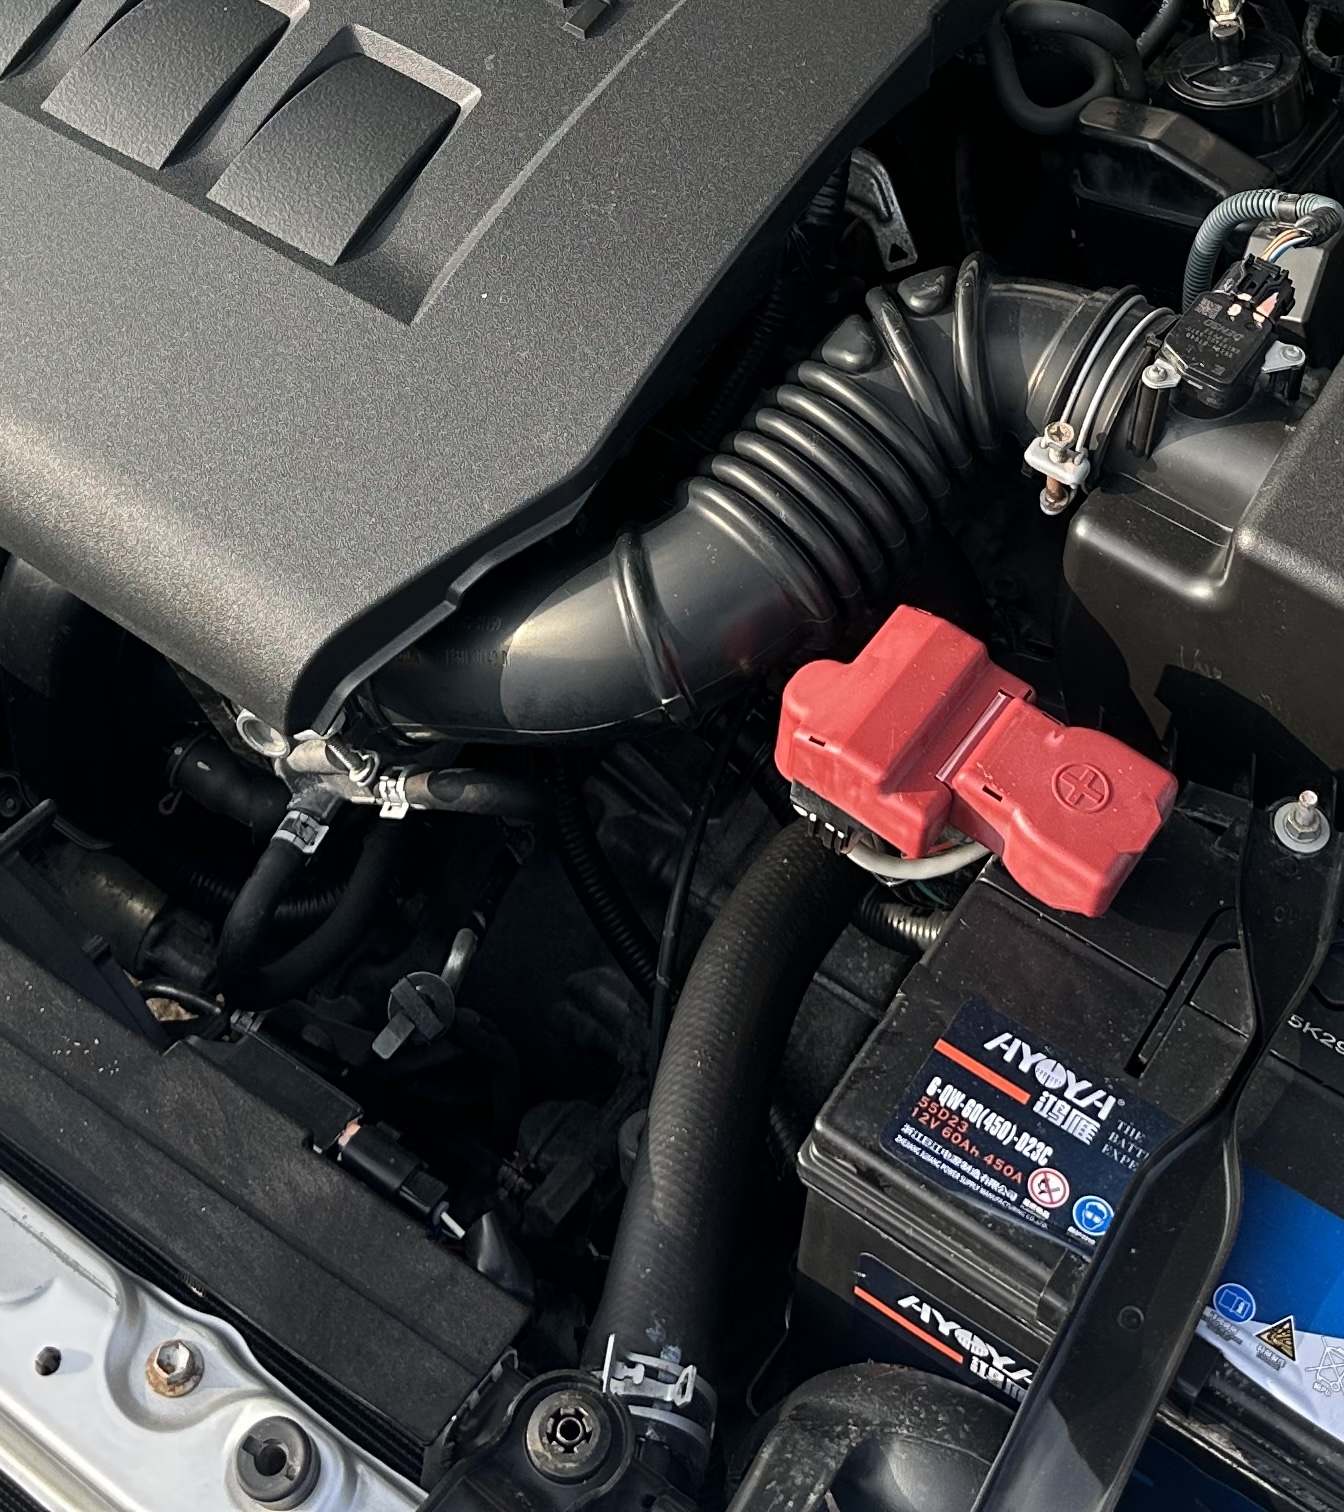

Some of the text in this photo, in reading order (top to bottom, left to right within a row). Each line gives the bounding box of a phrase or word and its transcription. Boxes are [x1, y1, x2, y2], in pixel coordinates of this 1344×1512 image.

[916, 1096, 970, 1133] 55D23
[1116, 1118, 1146, 1144] THE
[910, 1107, 1024, 1185] 12V 60Ah 450A
[1101, 1143, 1141, 1173] EXPE
